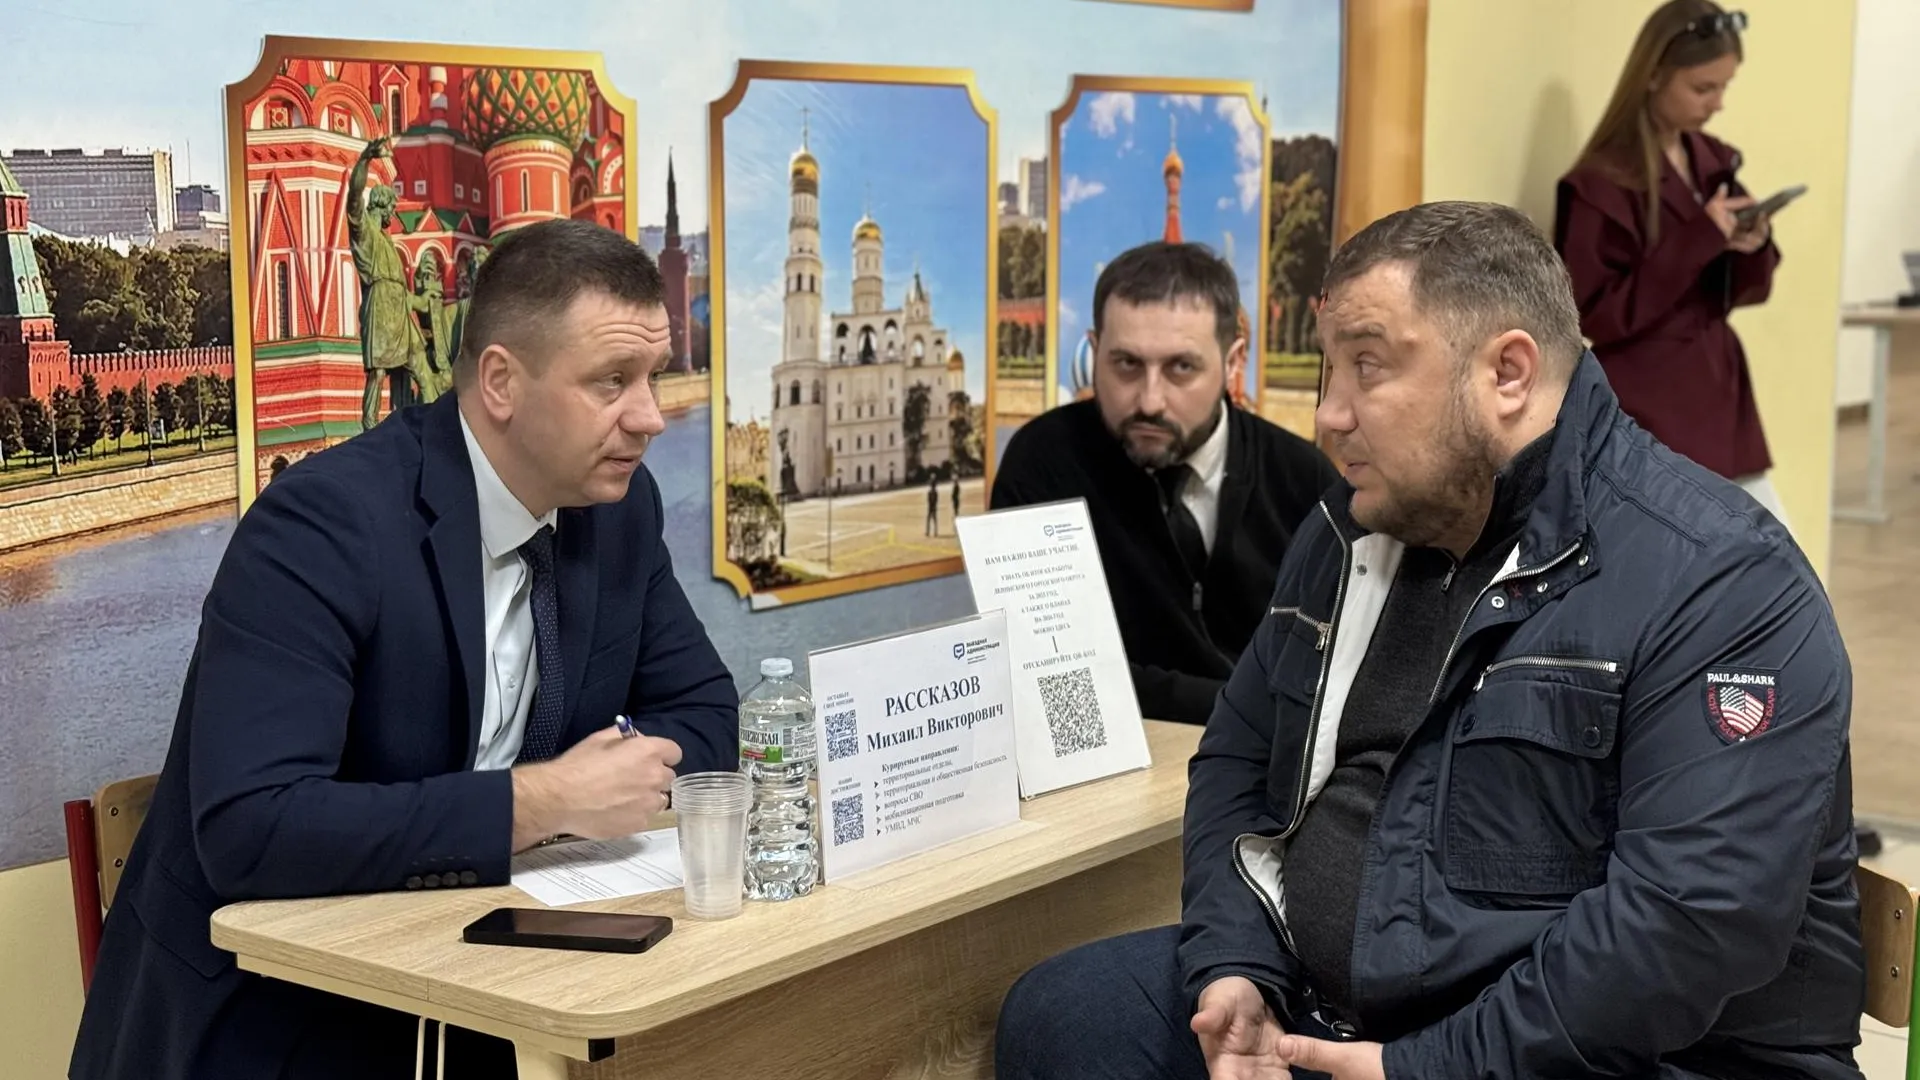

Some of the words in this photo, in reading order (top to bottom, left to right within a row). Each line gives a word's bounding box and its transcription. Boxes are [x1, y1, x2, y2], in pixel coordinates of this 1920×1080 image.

[985, 555, 1001, 565] НАМ
[1002, 552, 1027, 563] ВАЖНО
[1028, 548, 1048, 558] ВАШЕ
[1025, 604, 1044, 613] ТАКЖЕ
[1023, 654, 1072, 670] ОТСКАНИРУЙТЕ
[1707, 673, 1775, 685] PAUL&SHARK
[885, 676, 981, 717] РАССКАЗОВ
[867, 725, 924, 752] Михаил
[927, 703, 1003, 736] Викторович
[882, 756, 919, 773] Курируемые
[920, 745, 960, 761] направления:
[883, 764, 931, 785] территориальные
[884, 778, 931, 797] территориальная
[936, 765, 973, 781] общественная
[974, 755, 1007, 769] безопасность
[884, 797, 908, 810] вопросы
[909, 791, 923, 802] СВО
[885, 801, 934, 821] мобилизационная
[935, 791, 965, 806] подготовка
[907, 815, 922, 827] МЧС
